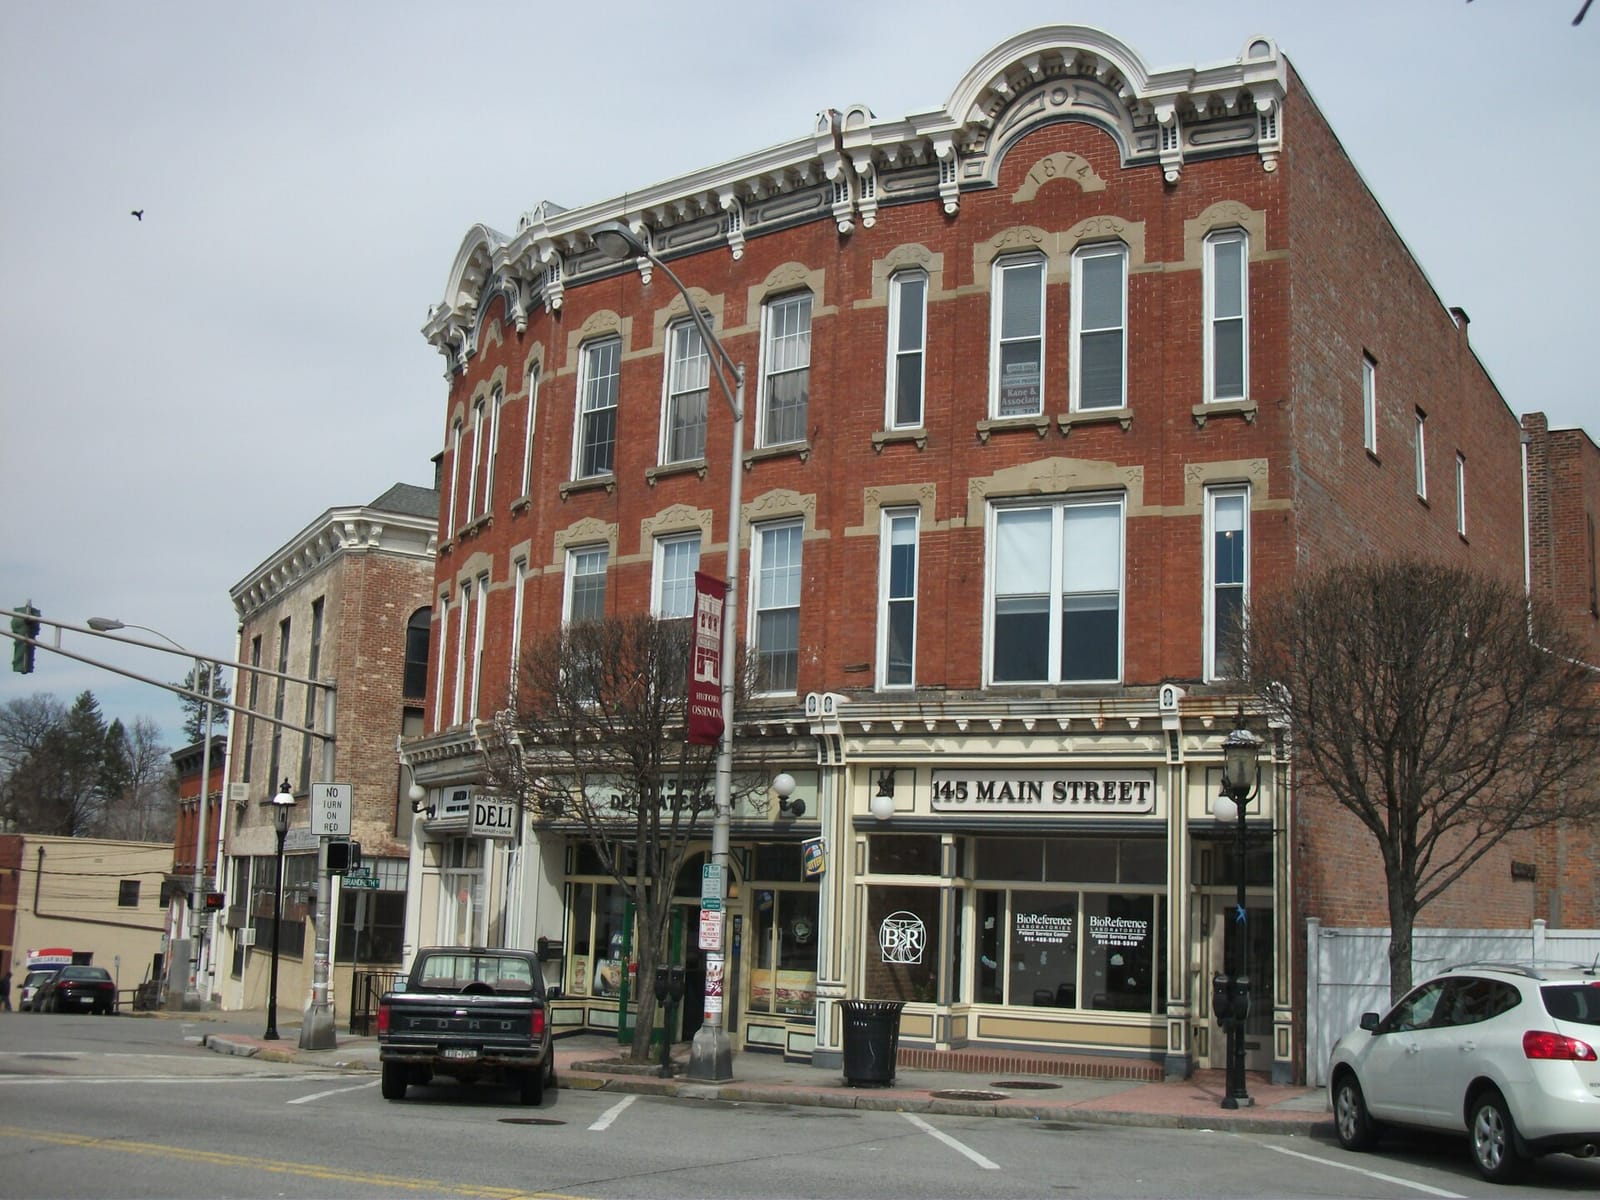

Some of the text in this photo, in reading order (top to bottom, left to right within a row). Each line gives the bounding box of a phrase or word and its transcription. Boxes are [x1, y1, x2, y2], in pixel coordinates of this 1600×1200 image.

[1029, 155, 1090, 185] 1874
[692, 705, 722, 719] OSSININ
[326, 787, 339, 798] NO
[932, 781, 1150, 802] 145 MAIN STREET
[323, 801, 342, 809] TURN
[326, 811, 337, 820] ON
[475, 804, 513, 828] DELI
[324, 823, 339, 831] RED
[1016, 914, 1072, 926] BioReference
[1090, 916, 1147, 928] BioReference
[410, 1019, 511, 1030] FORD
